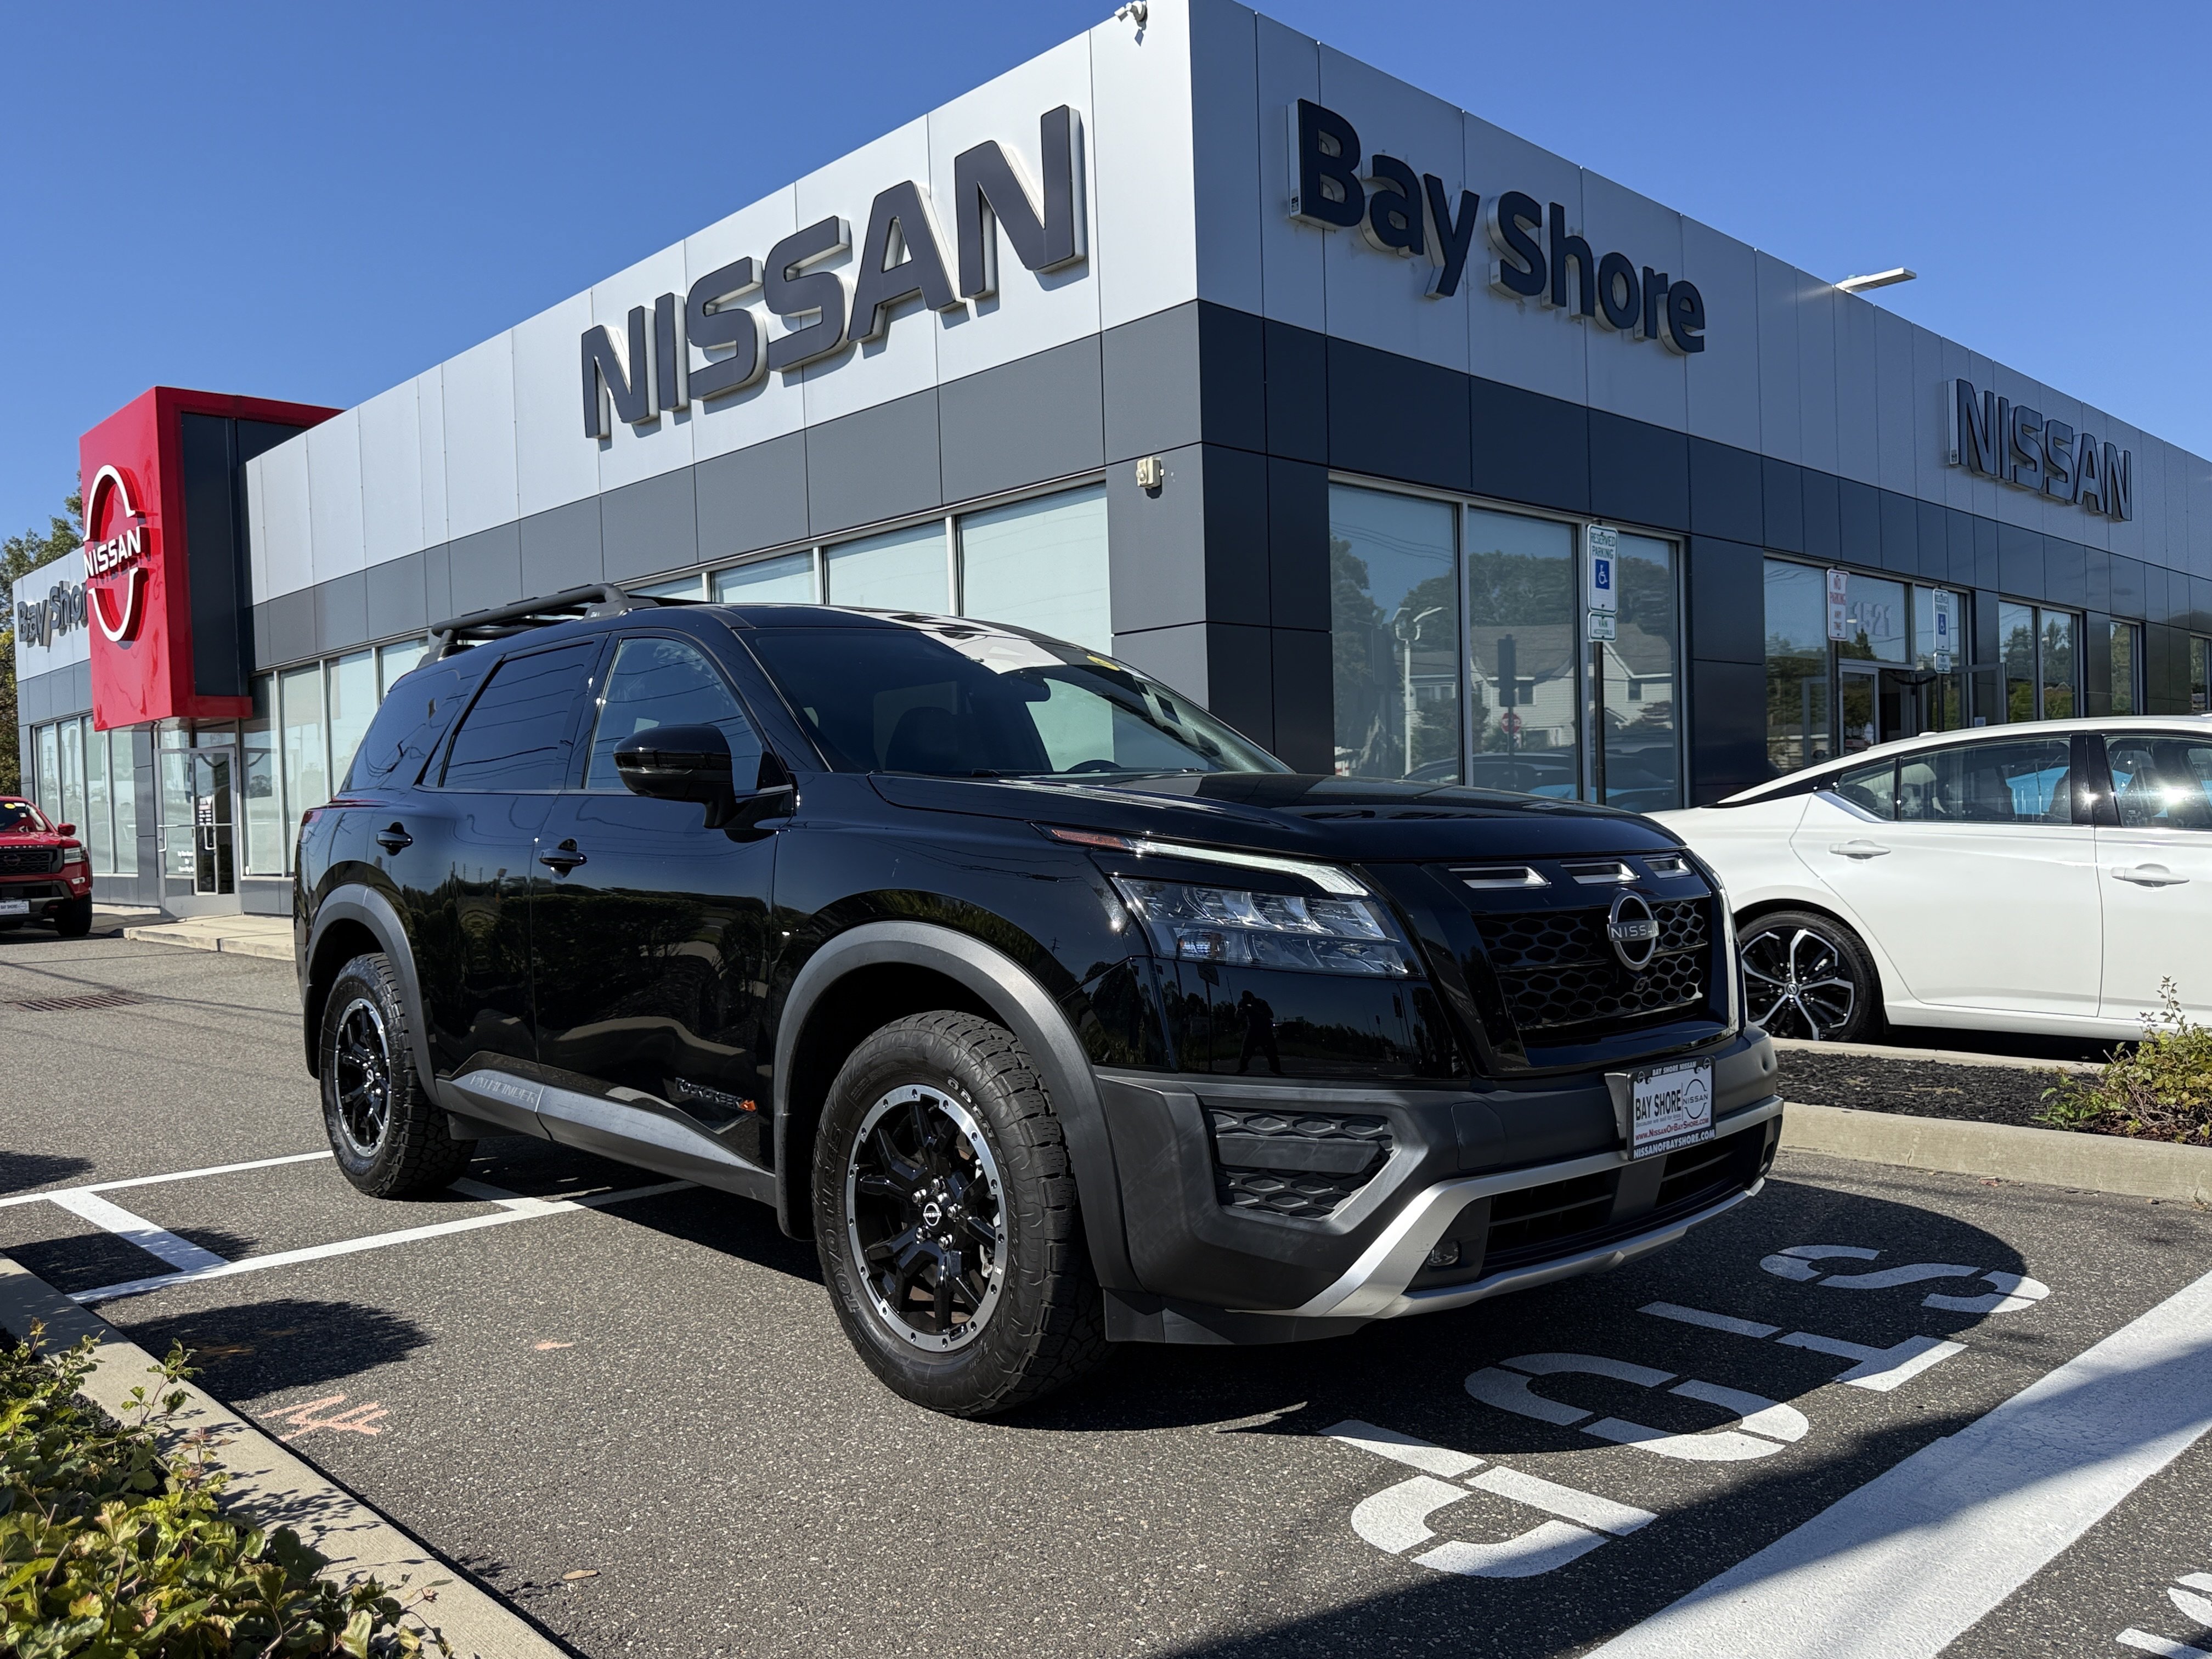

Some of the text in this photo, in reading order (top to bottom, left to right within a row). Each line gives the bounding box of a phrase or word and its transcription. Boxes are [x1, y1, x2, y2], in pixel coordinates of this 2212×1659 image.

[1288, 98, 1705, 356] Bay Shore
[582, 104, 1086, 438] NISSAN
[1949, 378, 2132, 522] NISSAN
[83, 526, 141, 578] NISSAN
[1591, 532, 1615, 547] RESERVED
[1592, 545, 1614, 560] PARKING
[1833, 577, 1841, 590] NO
[17, 580, 88, 647] Bay Shor
[1598, 619, 1608, 628] VAN
[1611, 924, 1658, 938] NISSAN
[1663, 1065, 1679, 1074] SHORE
[1679, 1061, 1697, 1070] NISSAN
[470, 1075, 536, 1103] PATHFINDER
[1683, 1093, 1708, 1105] NISSAN
[1636, 1089, 1681, 1121] BAY SHORE
[1633, 1129, 1716, 1159] NISSANOFBAYSHORE.COM
[825, 1228, 860, 1314] TOYO
[1319, 1244, 2051, 1578] STOP
